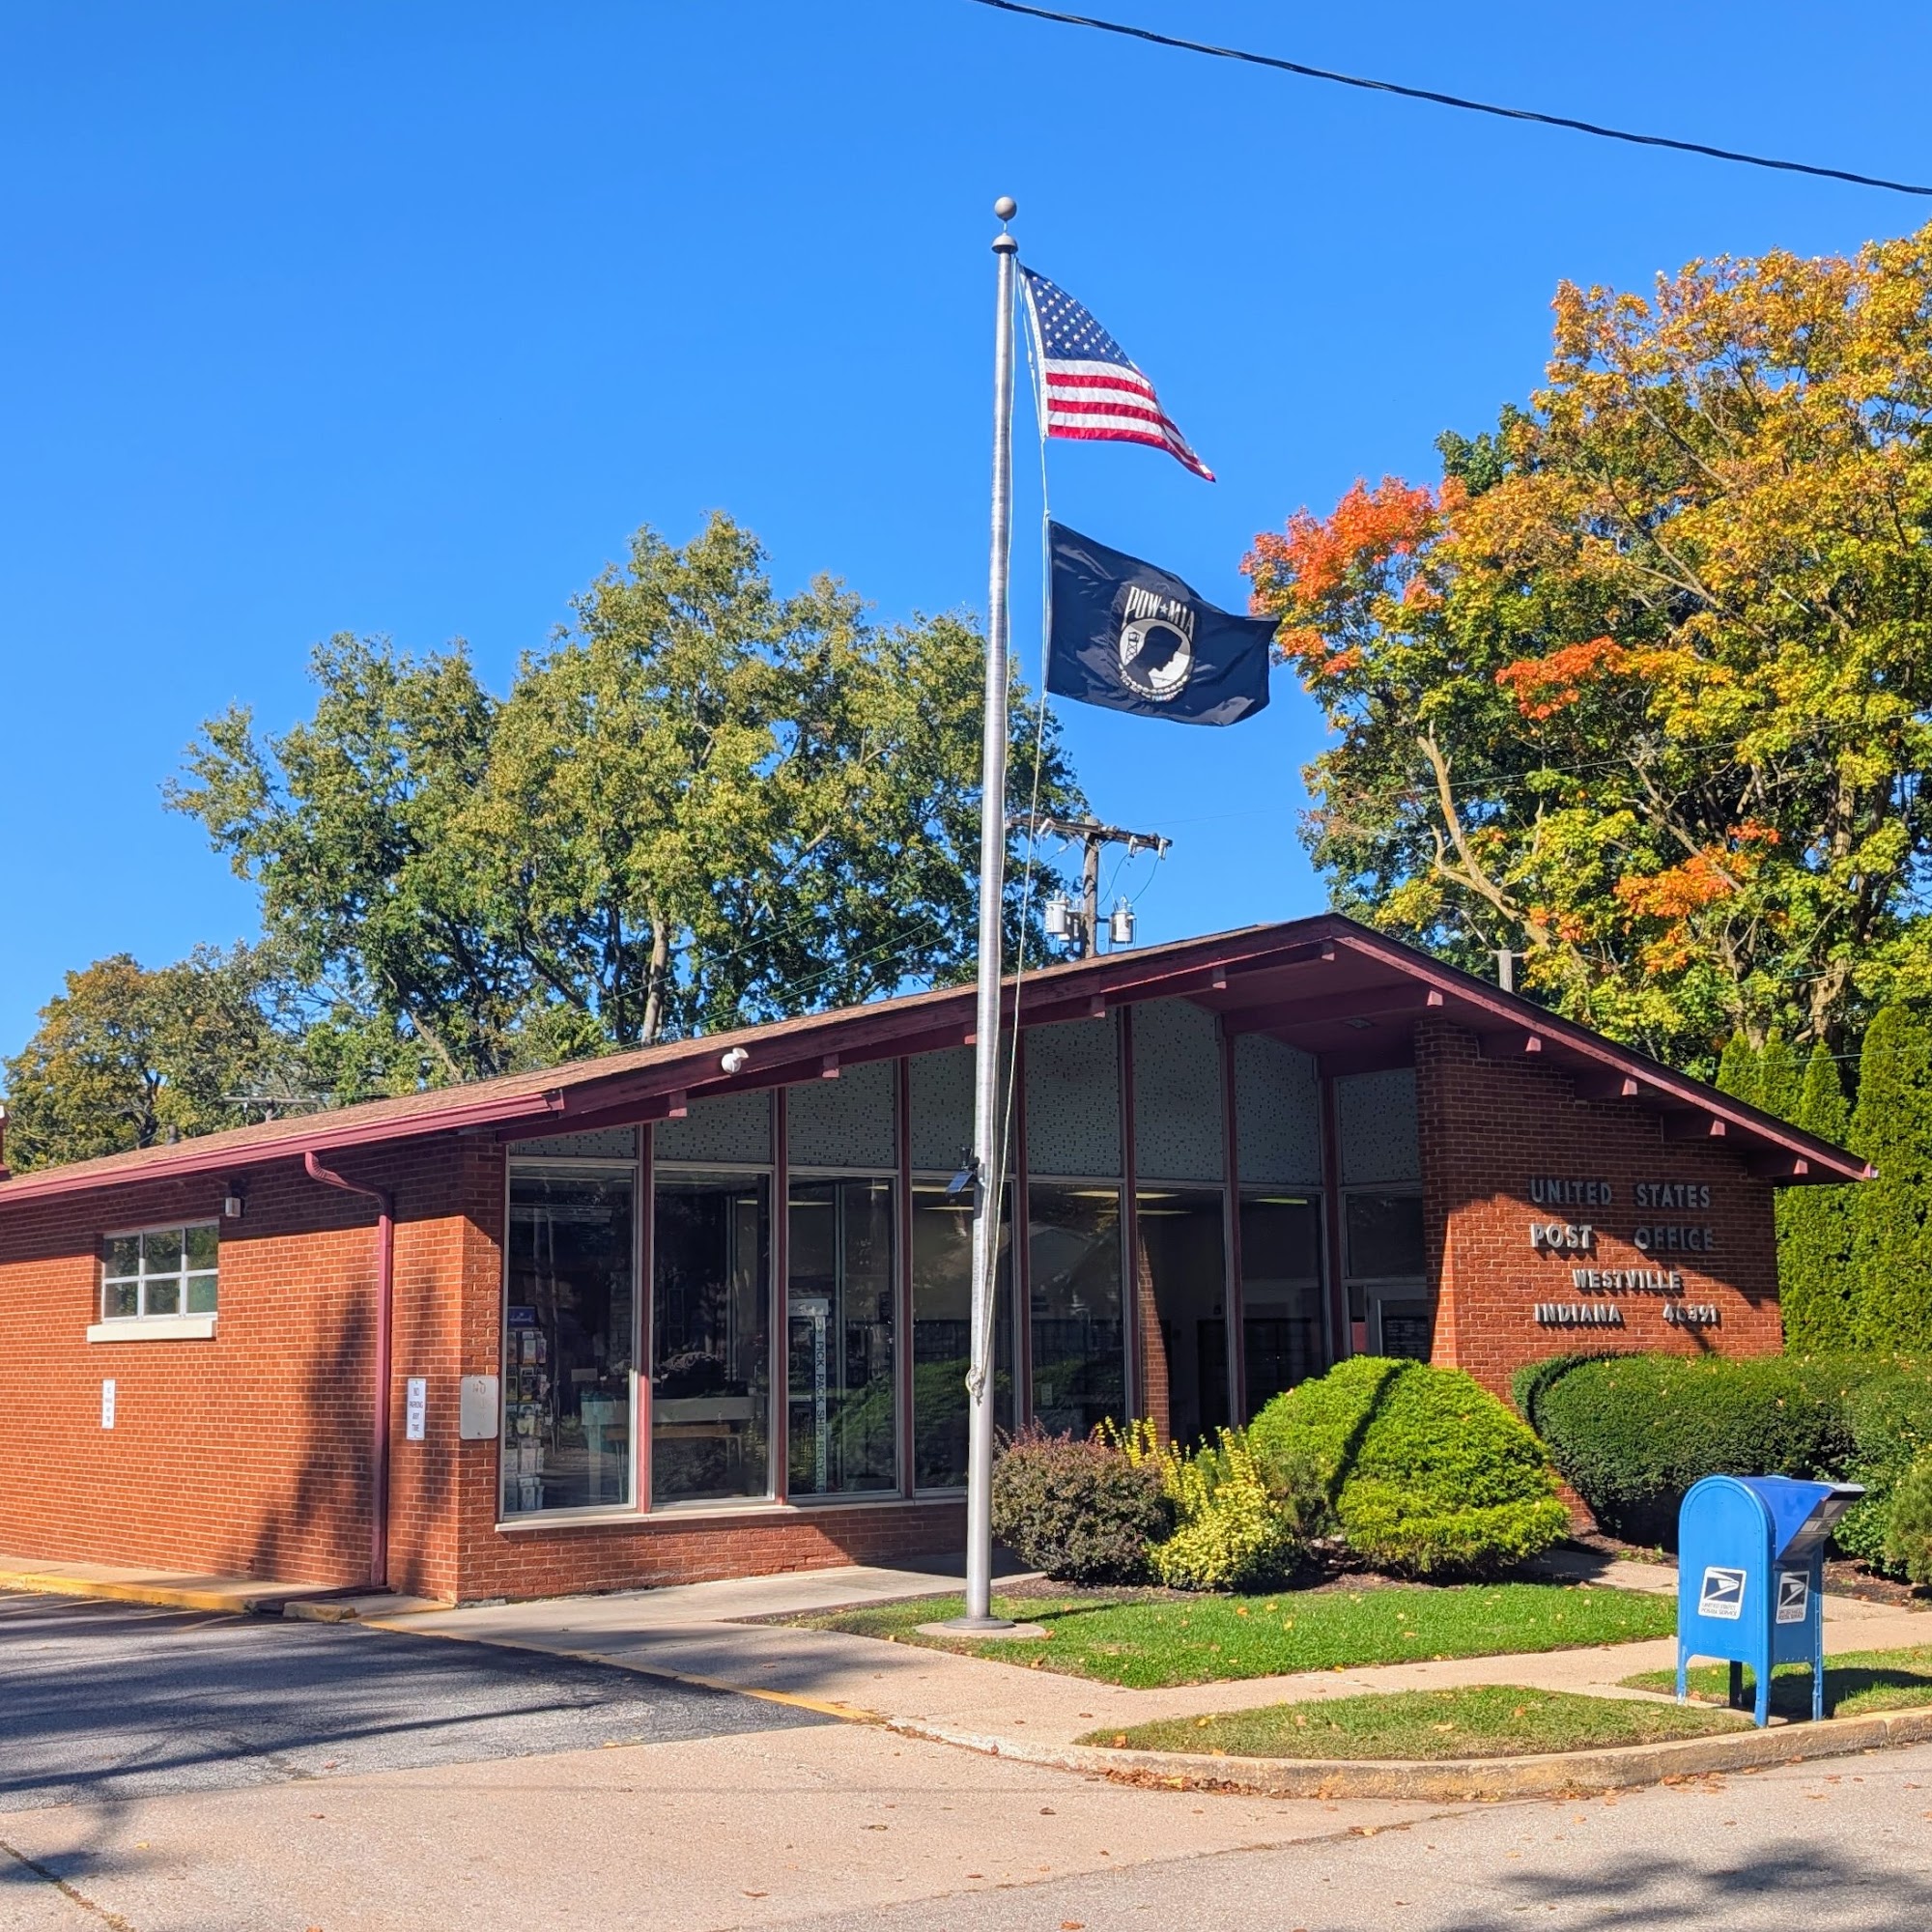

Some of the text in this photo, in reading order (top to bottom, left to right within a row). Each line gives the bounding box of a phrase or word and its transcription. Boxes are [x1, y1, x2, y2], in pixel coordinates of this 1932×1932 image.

[1122, 585, 1195, 641] POW MIA
[1530, 1179, 1710, 1208] UNITED STATES
[1530, 1223, 1714, 1250] POST OFFICE
[1572, 1268, 1681, 1289] WESTVILLE
[1534, 1303, 1717, 1322] INDIANA 46391
